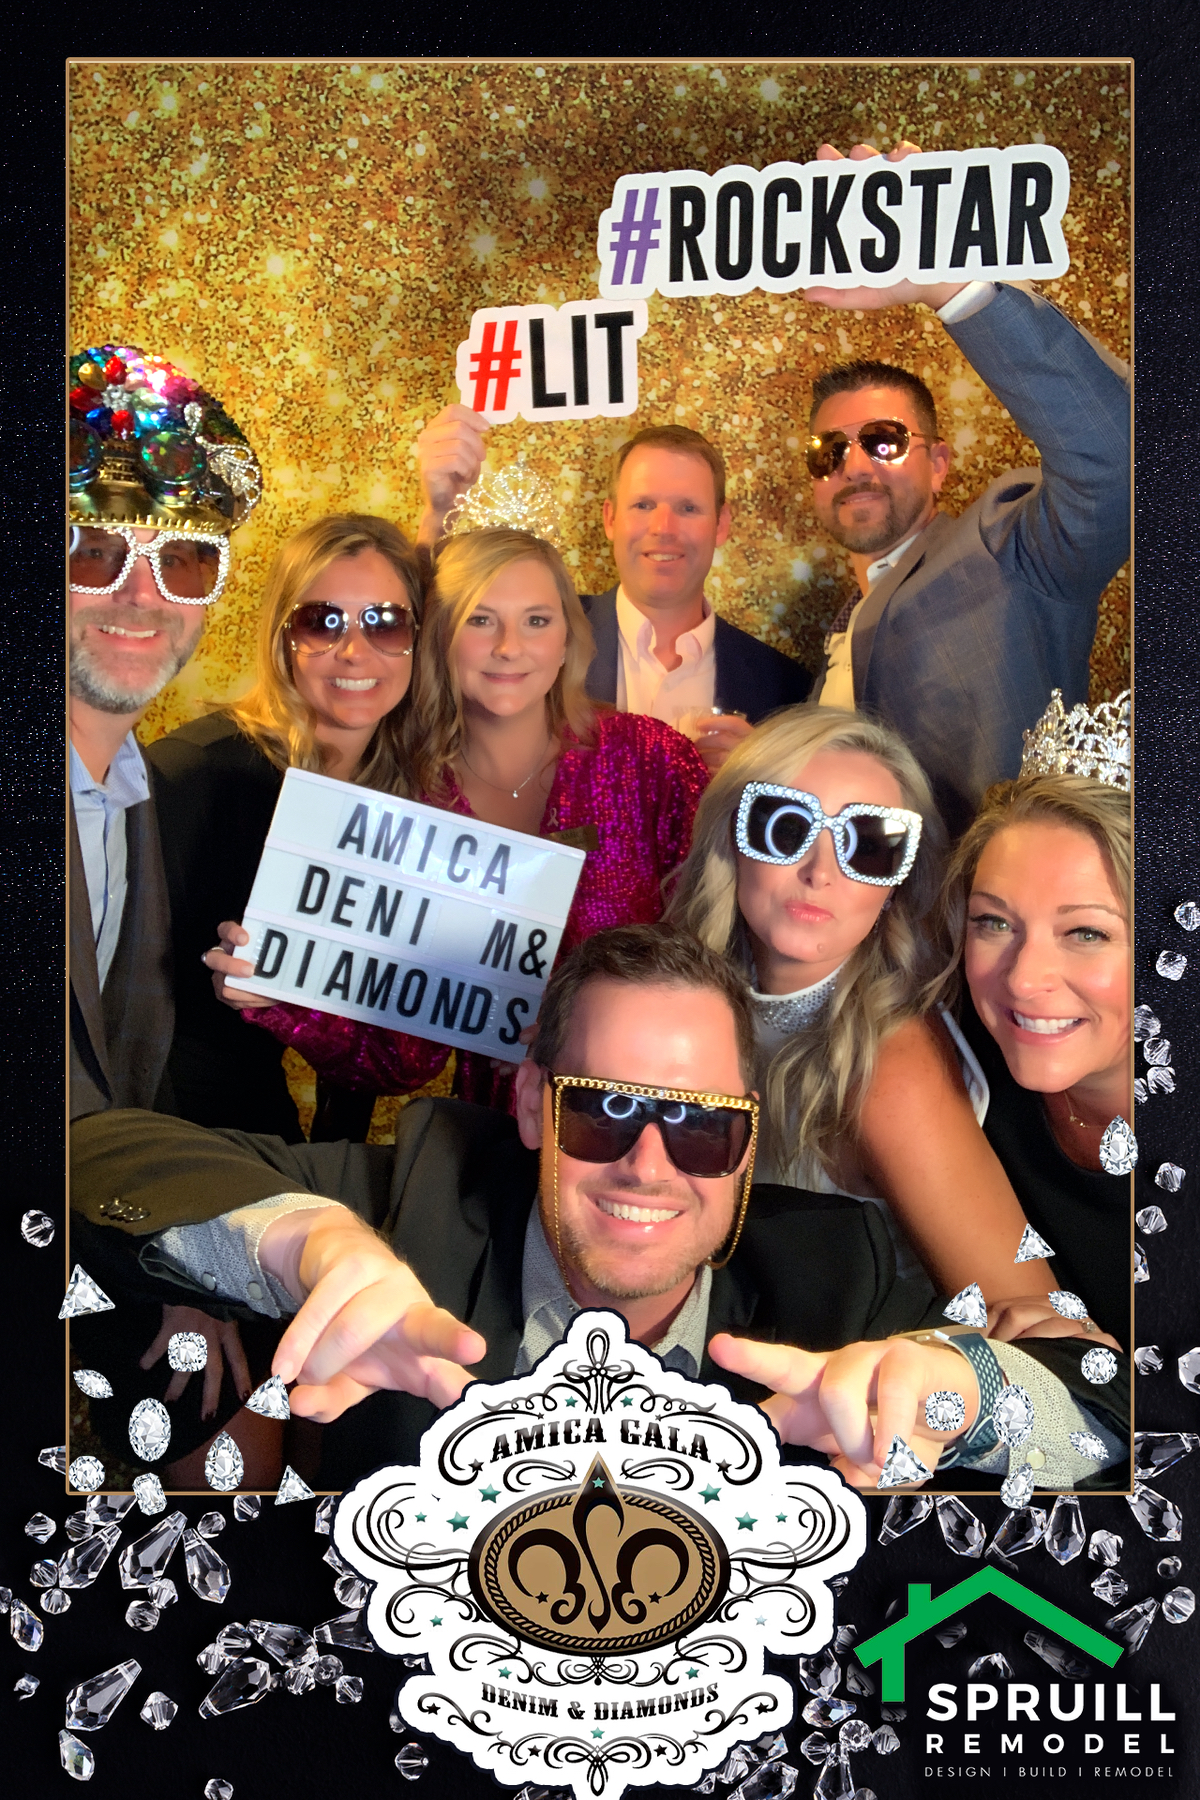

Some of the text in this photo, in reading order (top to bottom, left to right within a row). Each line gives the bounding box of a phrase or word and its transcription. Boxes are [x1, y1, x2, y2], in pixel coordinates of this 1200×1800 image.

[609, 161, 1053, 286] #ROCKSTAR
[469, 310, 635, 413] #LIT
[336, 802, 513, 895] AMICA
[296, 864, 431, 946] DENI
[253, 928, 530, 1046] DIAMONDS
